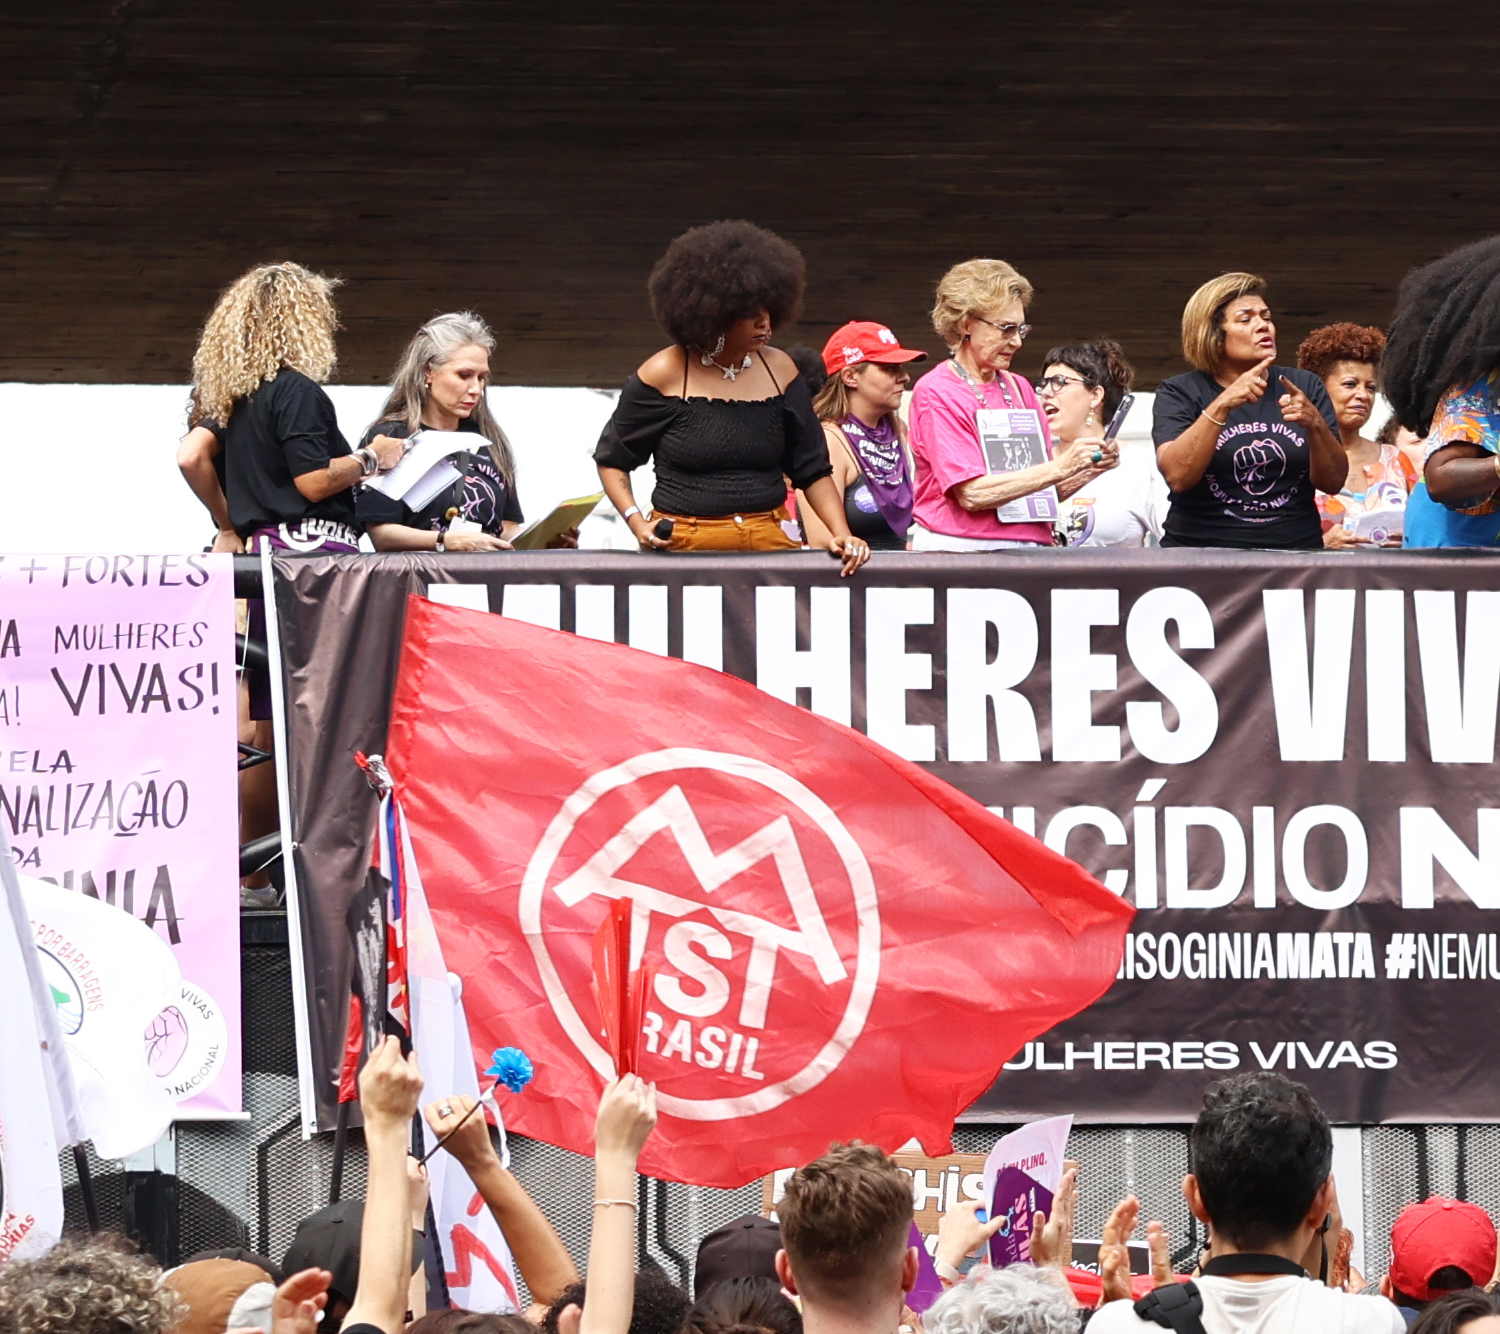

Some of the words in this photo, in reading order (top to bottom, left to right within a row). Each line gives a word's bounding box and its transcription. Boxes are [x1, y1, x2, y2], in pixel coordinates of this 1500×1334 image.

[1215, 421, 1268, 451] MULHERES
[1271, 423, 1305, 447] VIVAS
[62, 553, 210, 589] FORTES
[54, 621, 209, 655] MULHERES
[50, 661, 220, 717] VIVAS!
[56, 941, 105, 1012] BARRAGENS
[1116, 931, 1376, 982] ISOGINIAMATA
[180, 987, 215, 1021] VIVAS
[601, 1004, 767, 1084] RASIL
[1002, 1041, 1240, 1073] ULHERES
[1249, 1040, 1399, 1072] VIVAS
[175, 1042, 220, 1097] NACIONAL
